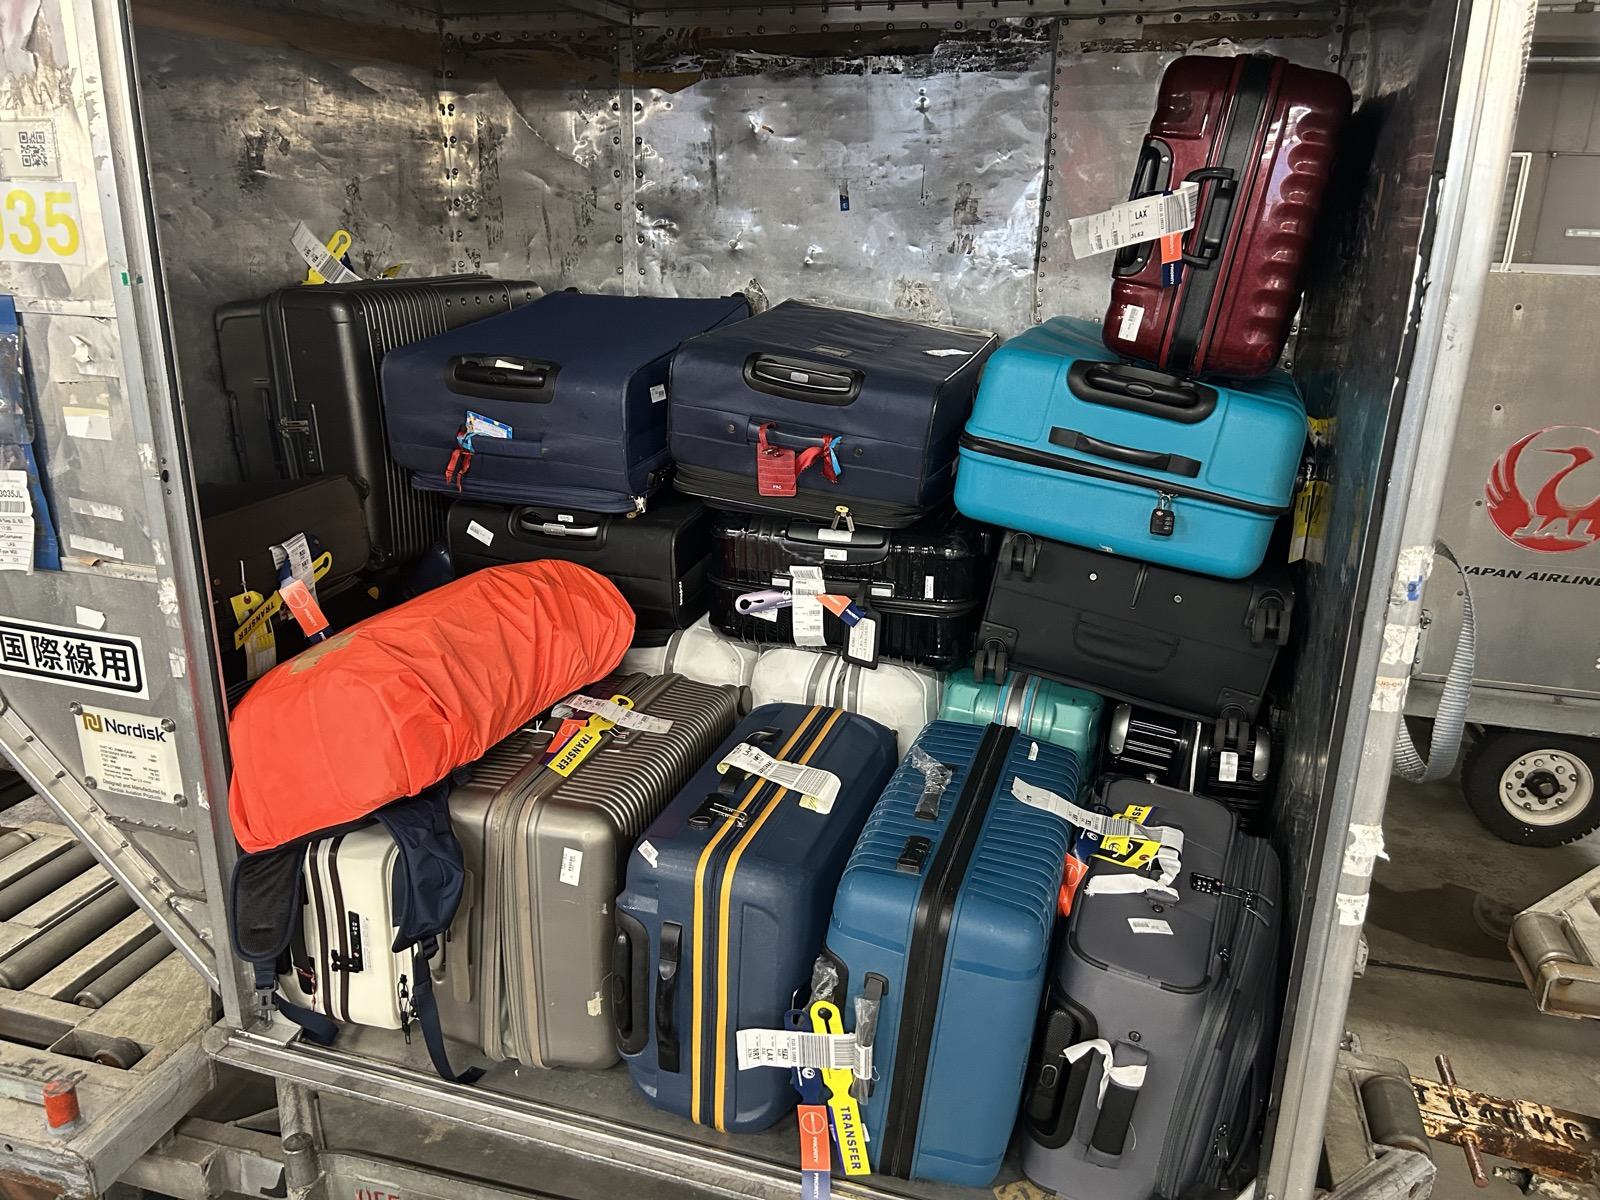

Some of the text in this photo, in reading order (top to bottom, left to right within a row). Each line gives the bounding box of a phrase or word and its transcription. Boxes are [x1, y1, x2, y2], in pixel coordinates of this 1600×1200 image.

[0, 189, 79, 257] 35
[1135, 209, 1148, 219] LAX
[1511, 515, 1596, 543] JAL
[238, 601, 275, 641] TRANSFER
[0, 630, 131, 682] 国際線用
[104, 717, 167, 742] Nordisk
[556, 733, 593, 770] TRANSFER
[752, 1048, 760, 1060] NRT
[766, 1048, 775, 1062] LAX
[840, 1106, 861, 1169] TRANSFER
